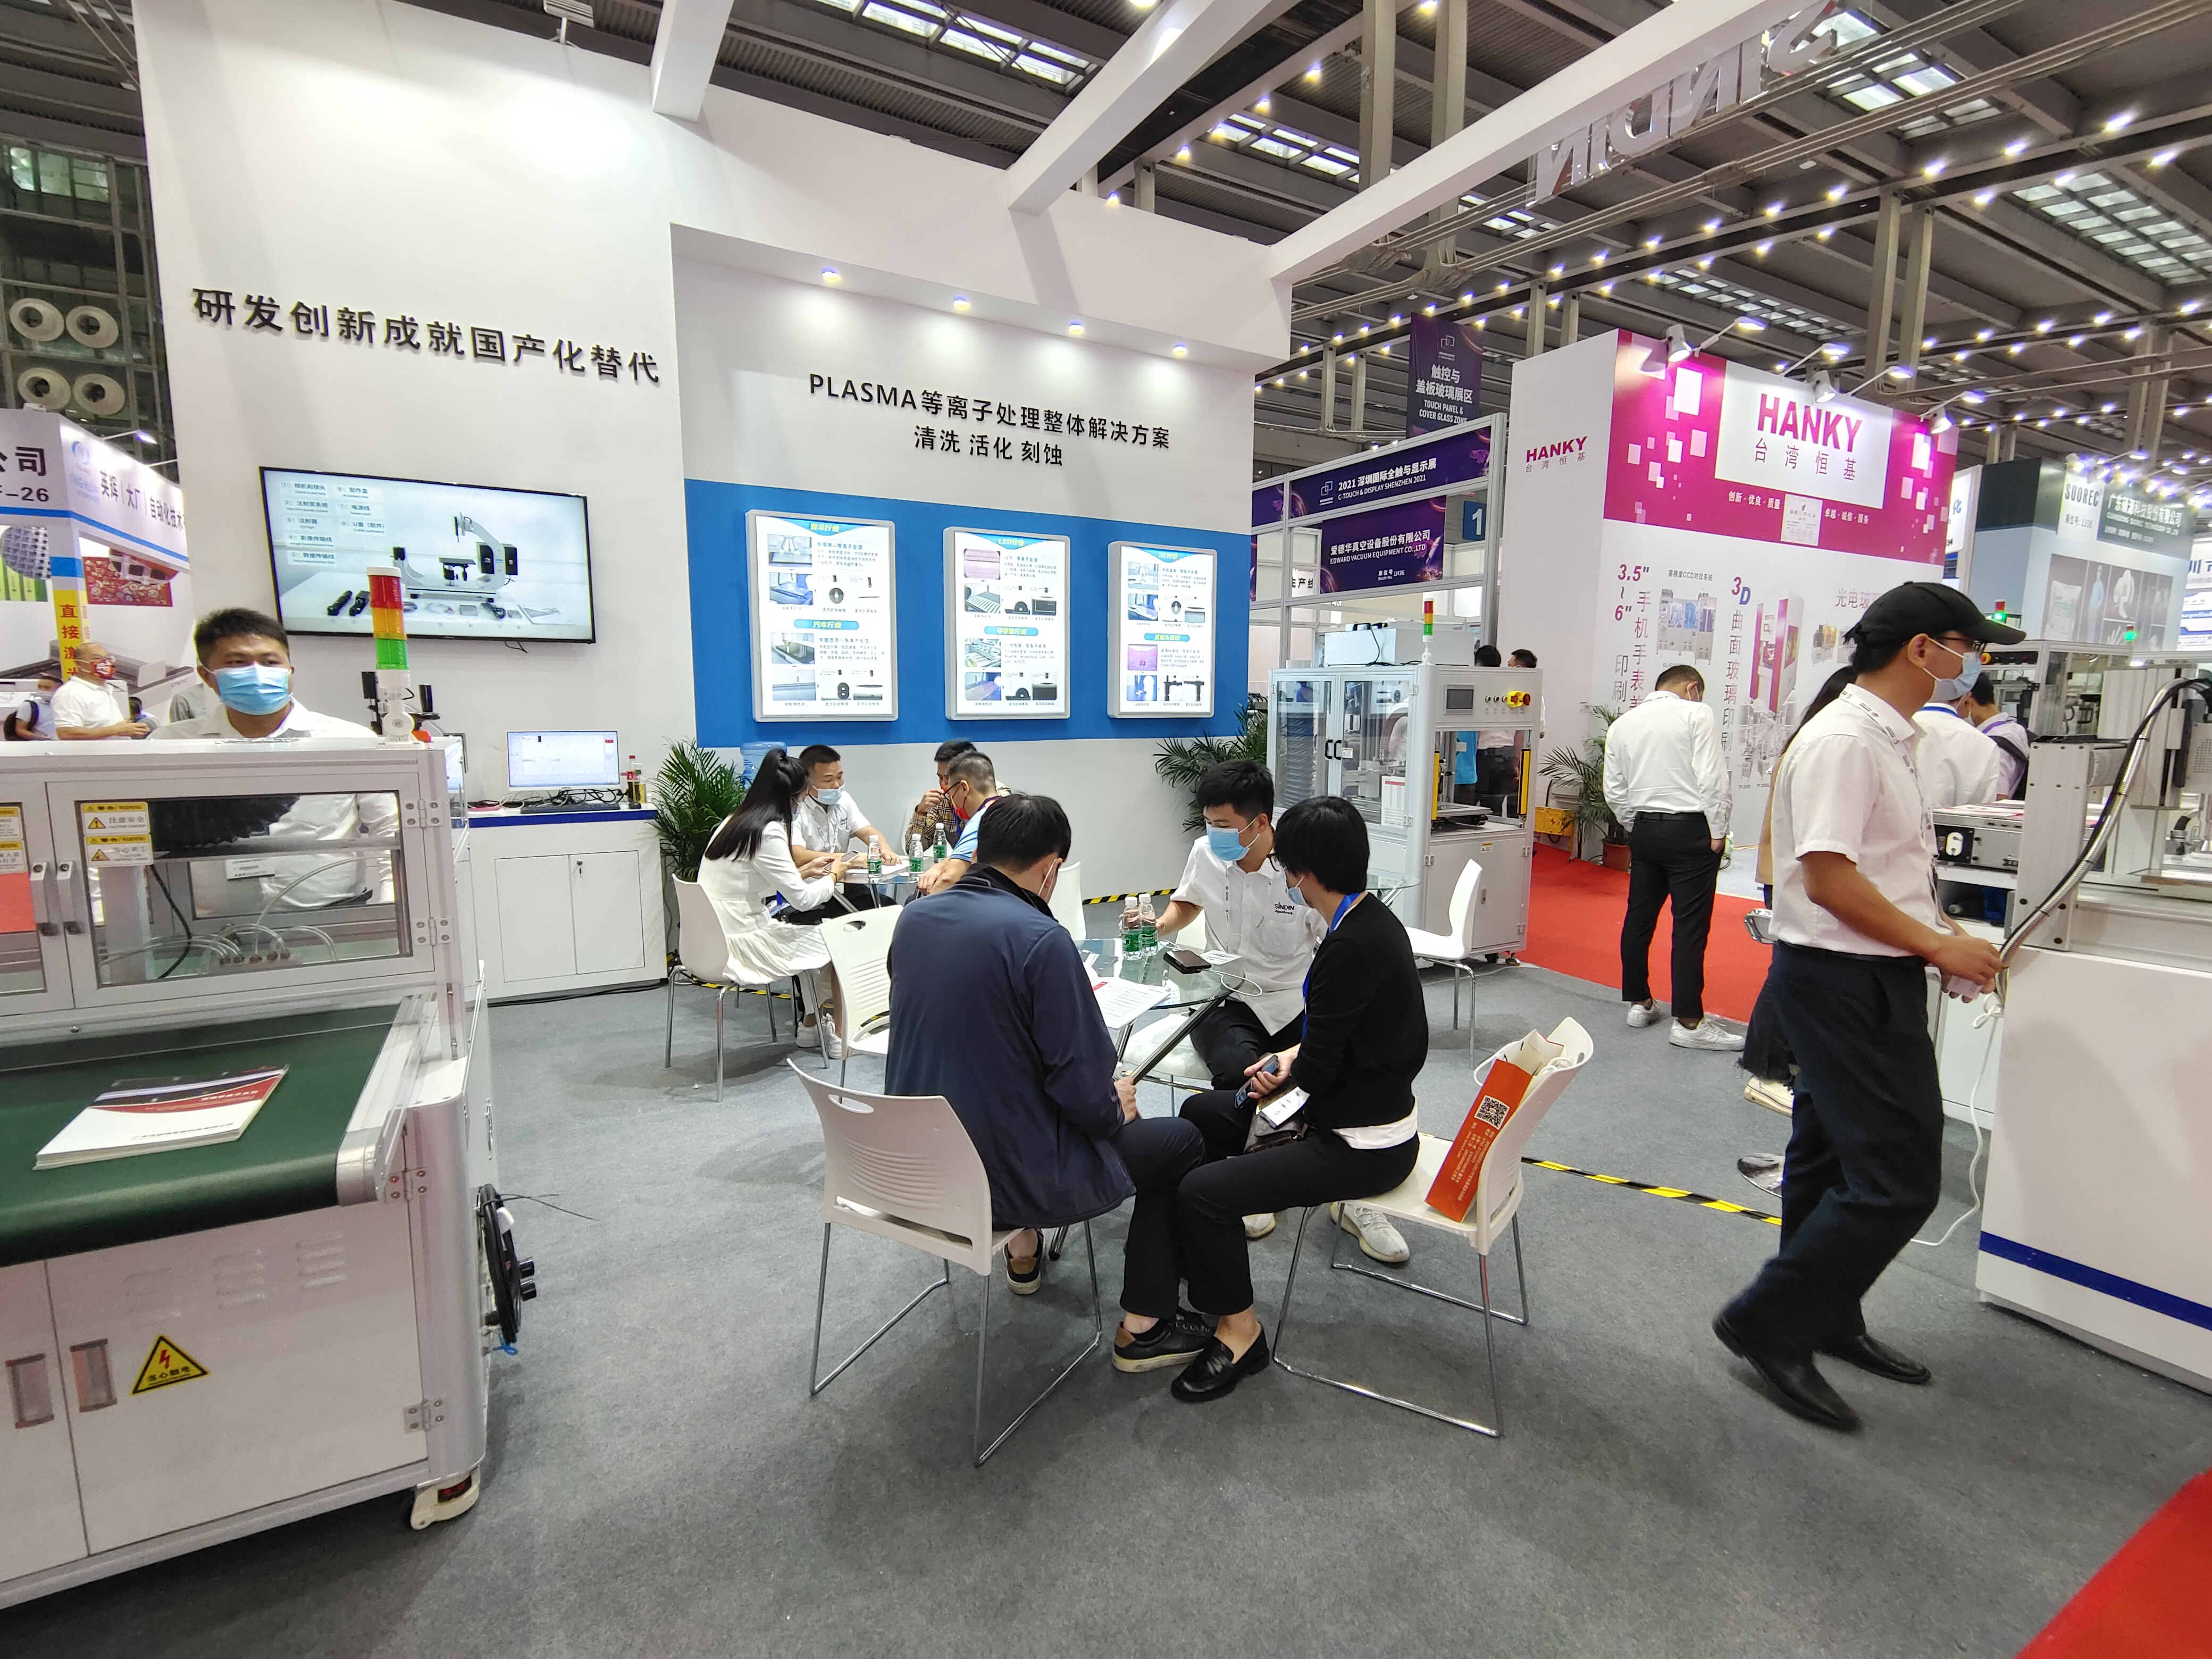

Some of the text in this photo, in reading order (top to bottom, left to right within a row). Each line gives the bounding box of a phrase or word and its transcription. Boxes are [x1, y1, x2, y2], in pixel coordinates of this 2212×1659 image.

[192, 288, 660, 383] 研发创新成就国产化替代
[1431, 364, 1460, 383] 触控与
[1415, 379, 1473, 404] 盖板玻璃展区
[809, 373, 1169, 449] PLASMA等离子处理整体解决方案
[1419, 409, 1436, 420] COVER
[1437, 413, 1453, 423] GLASS
[1424, 399, 1463, 415] TOUCH PANEL &
[1757, 392, 1863, 453] HANKY
[914, 425, 1063, 467] 清洗 活化 刻蚀
[1526, 435, 1588, 463] HANKY
[1755, 438, 1857, 481] 台湾恒基
[1338, 457, 1437, 491] 2021 深圳国际全触与显示展
[1338, 489, 1359, 500] C-TOUCH
[1364, 484, 1384, 495] DISPLAY
[1384, 478, 1412, 490] SHENZHEN
[1413, 474, 1426, 483] 2021
[0, 485, 49, 502] -26
[99, 470, 186, 531] 英辉（大厂）自动化技术
[2065, 483, 2099, 507] SUOREC
[1472, 508, 1482, 535] 1
[1330, 529, 1430, 556] 爱德华真空设备股份有限公司
[1330, 555, 1350, 565] EDWARD
[1351, 552, 1371, 562] VACUUM
[1372, 547, 1404, 559] EQUIPMENT
[1612, 653, 1629, 715] 印刷
